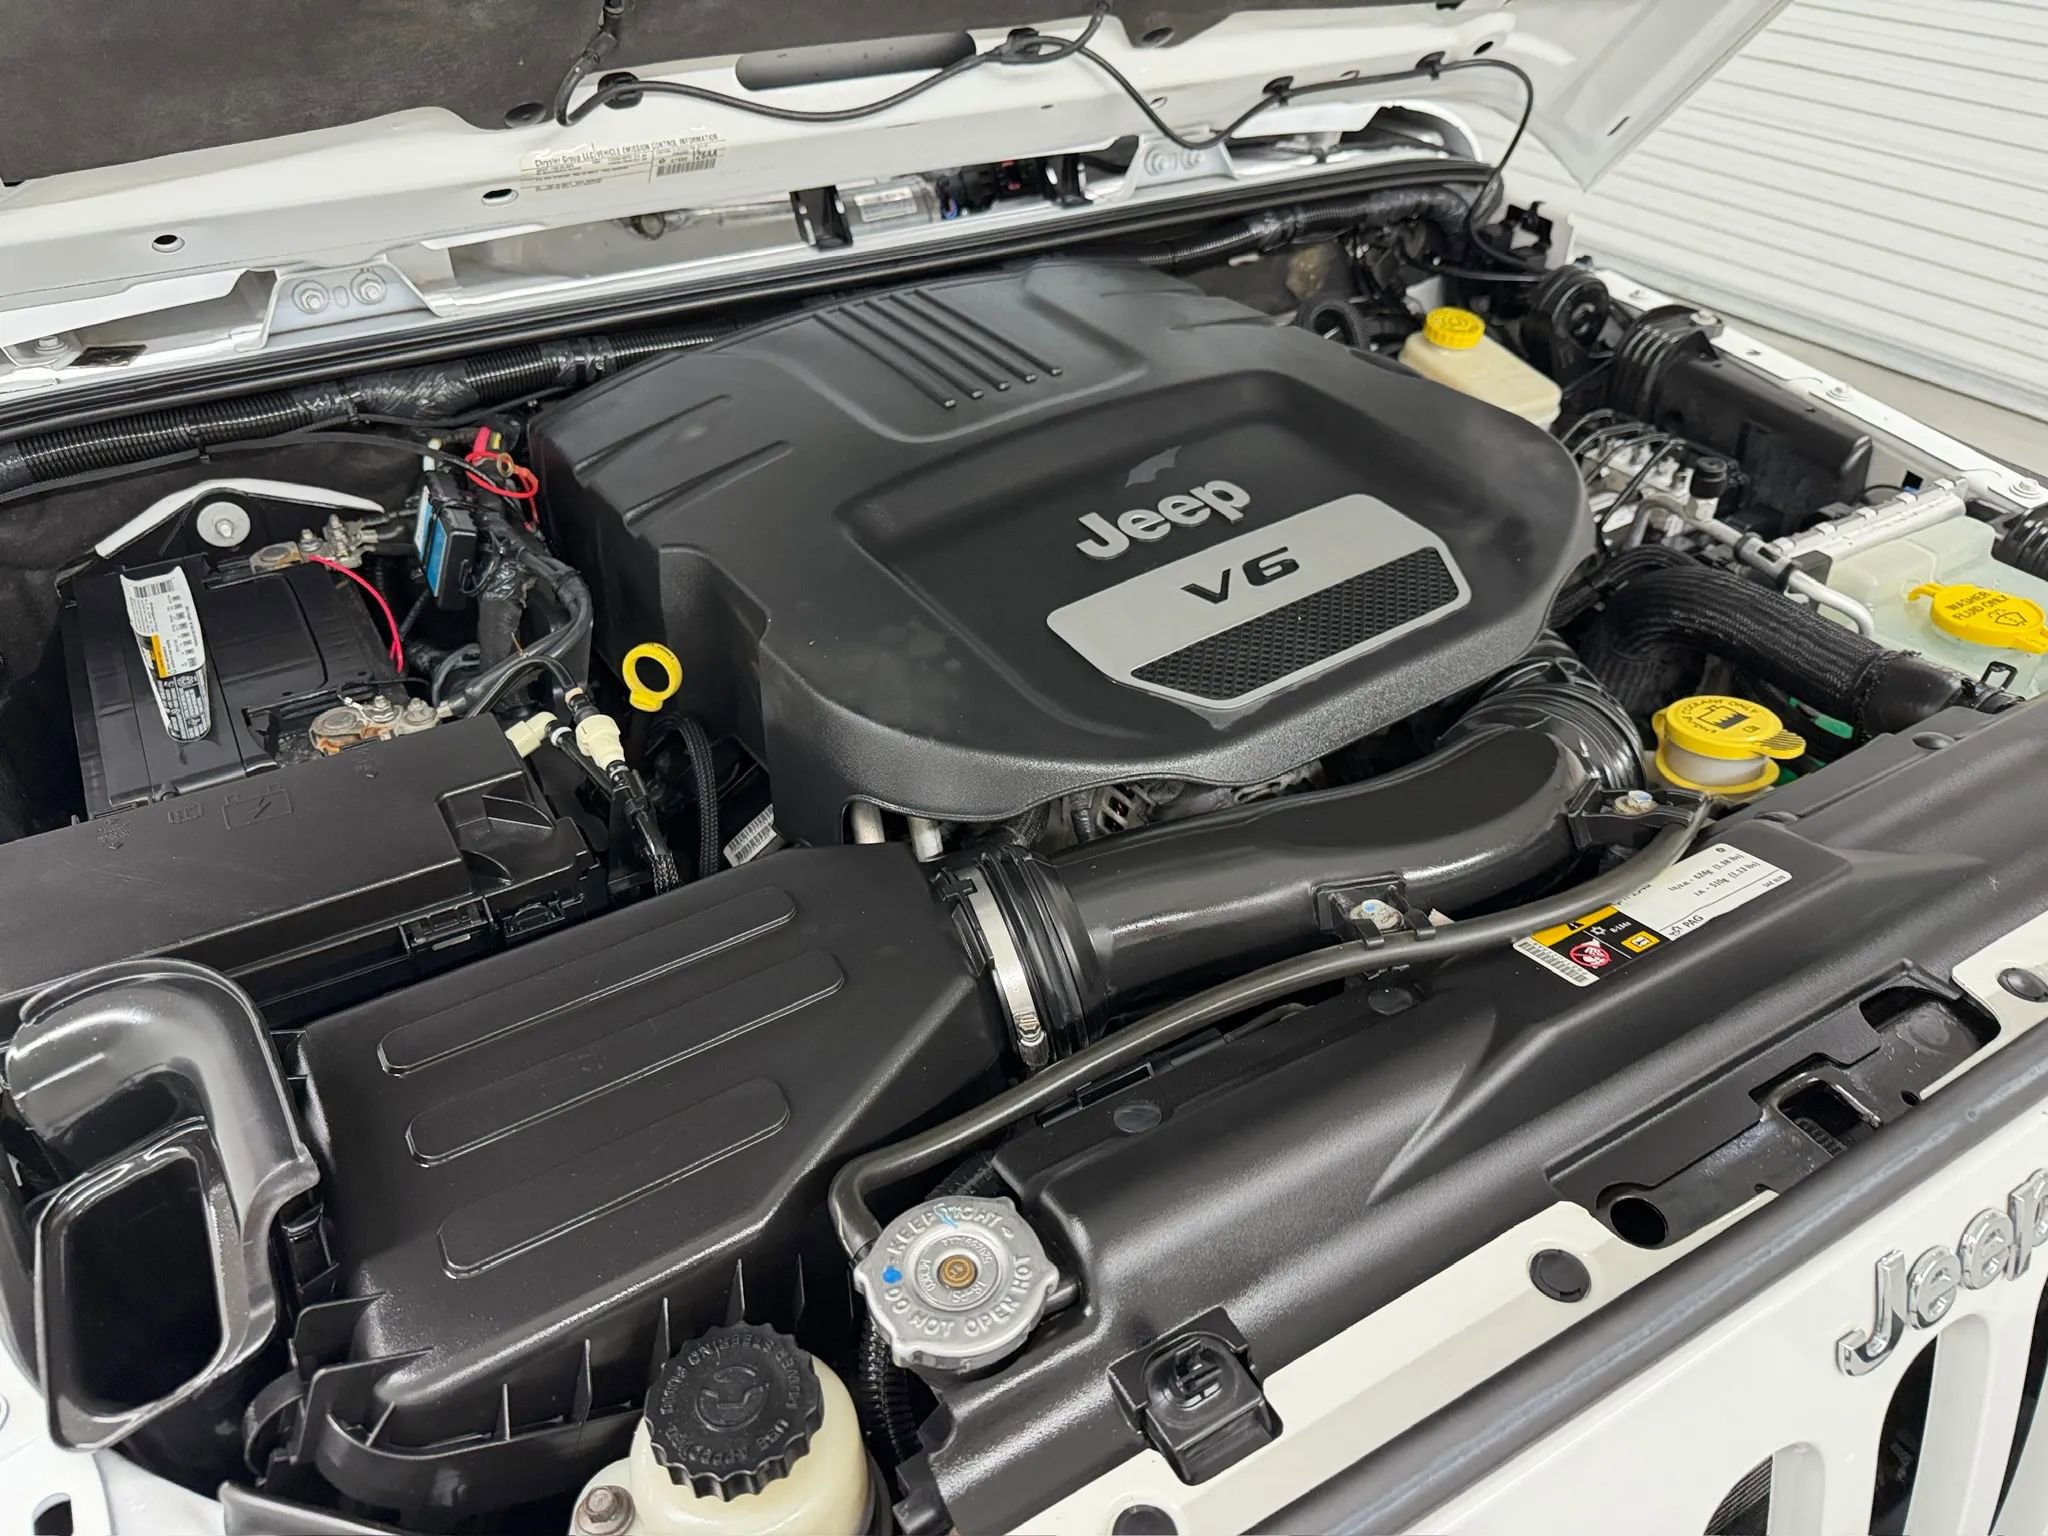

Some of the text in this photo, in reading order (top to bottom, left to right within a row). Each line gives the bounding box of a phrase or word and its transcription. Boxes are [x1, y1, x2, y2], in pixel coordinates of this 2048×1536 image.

[562, 154, 581, 164] Group
[583, 151, 593, 161] LLC
[622, 143, 650, 155] EMISSION
[651, 138, 680, 150] CONTROL
[679, 133, 718, 145] INFORMATION
[1075, 480, 1251, 560] Jeep
[1180, 546, 1299, 605] V6
[1683, 914, 1704, 929] PAG
[886, 1211, 936, 1255] KEEP
[883, 1254, 1034, 1338] DO NOT OPEN HOT
[1835, 1168, 2048, 1377] Jeep
